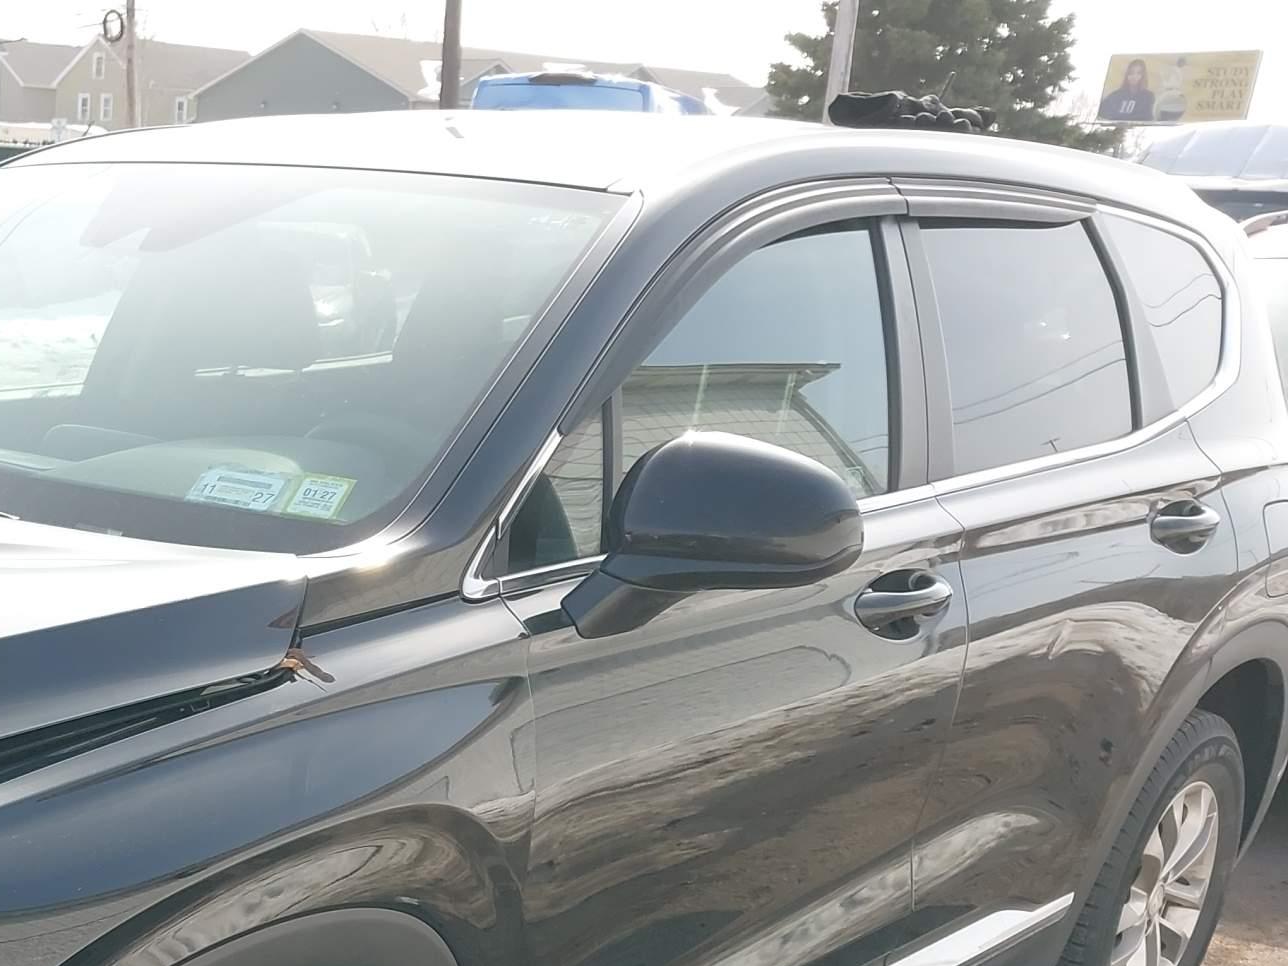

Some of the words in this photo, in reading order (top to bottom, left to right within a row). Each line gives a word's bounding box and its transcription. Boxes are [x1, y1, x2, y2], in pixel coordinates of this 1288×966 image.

[1207, 67, 1250, 77] STUDY
[1192, 78, 1250, 89] STRONG
[1211, 89, 1246, 99] PLAY
[1119, 100, 1136, 114] 10
[1195, 100, 1242, 110] SMART
[201, 482, 216, 494] 11
[253, 492, 275, 504] 27
